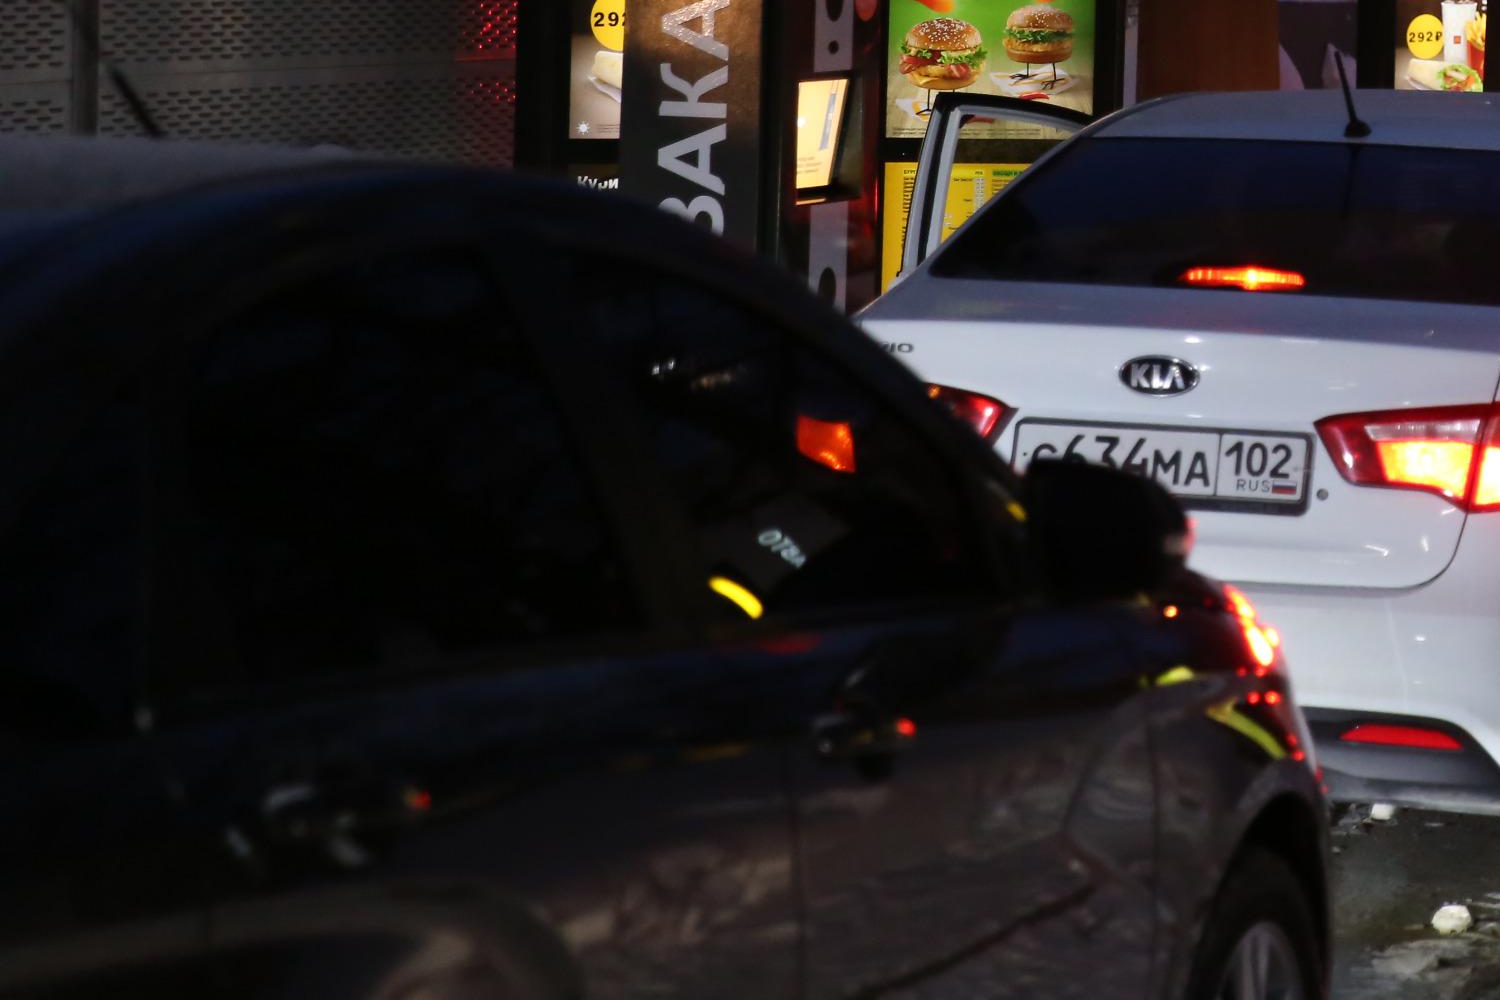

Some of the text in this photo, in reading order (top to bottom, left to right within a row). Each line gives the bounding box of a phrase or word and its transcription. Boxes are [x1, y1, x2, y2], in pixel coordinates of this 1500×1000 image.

[1130, 363, 1188, 390] KIA
[1224, 441, 1293, 480] 102
[1236, 478, 1271, 493] RUS
